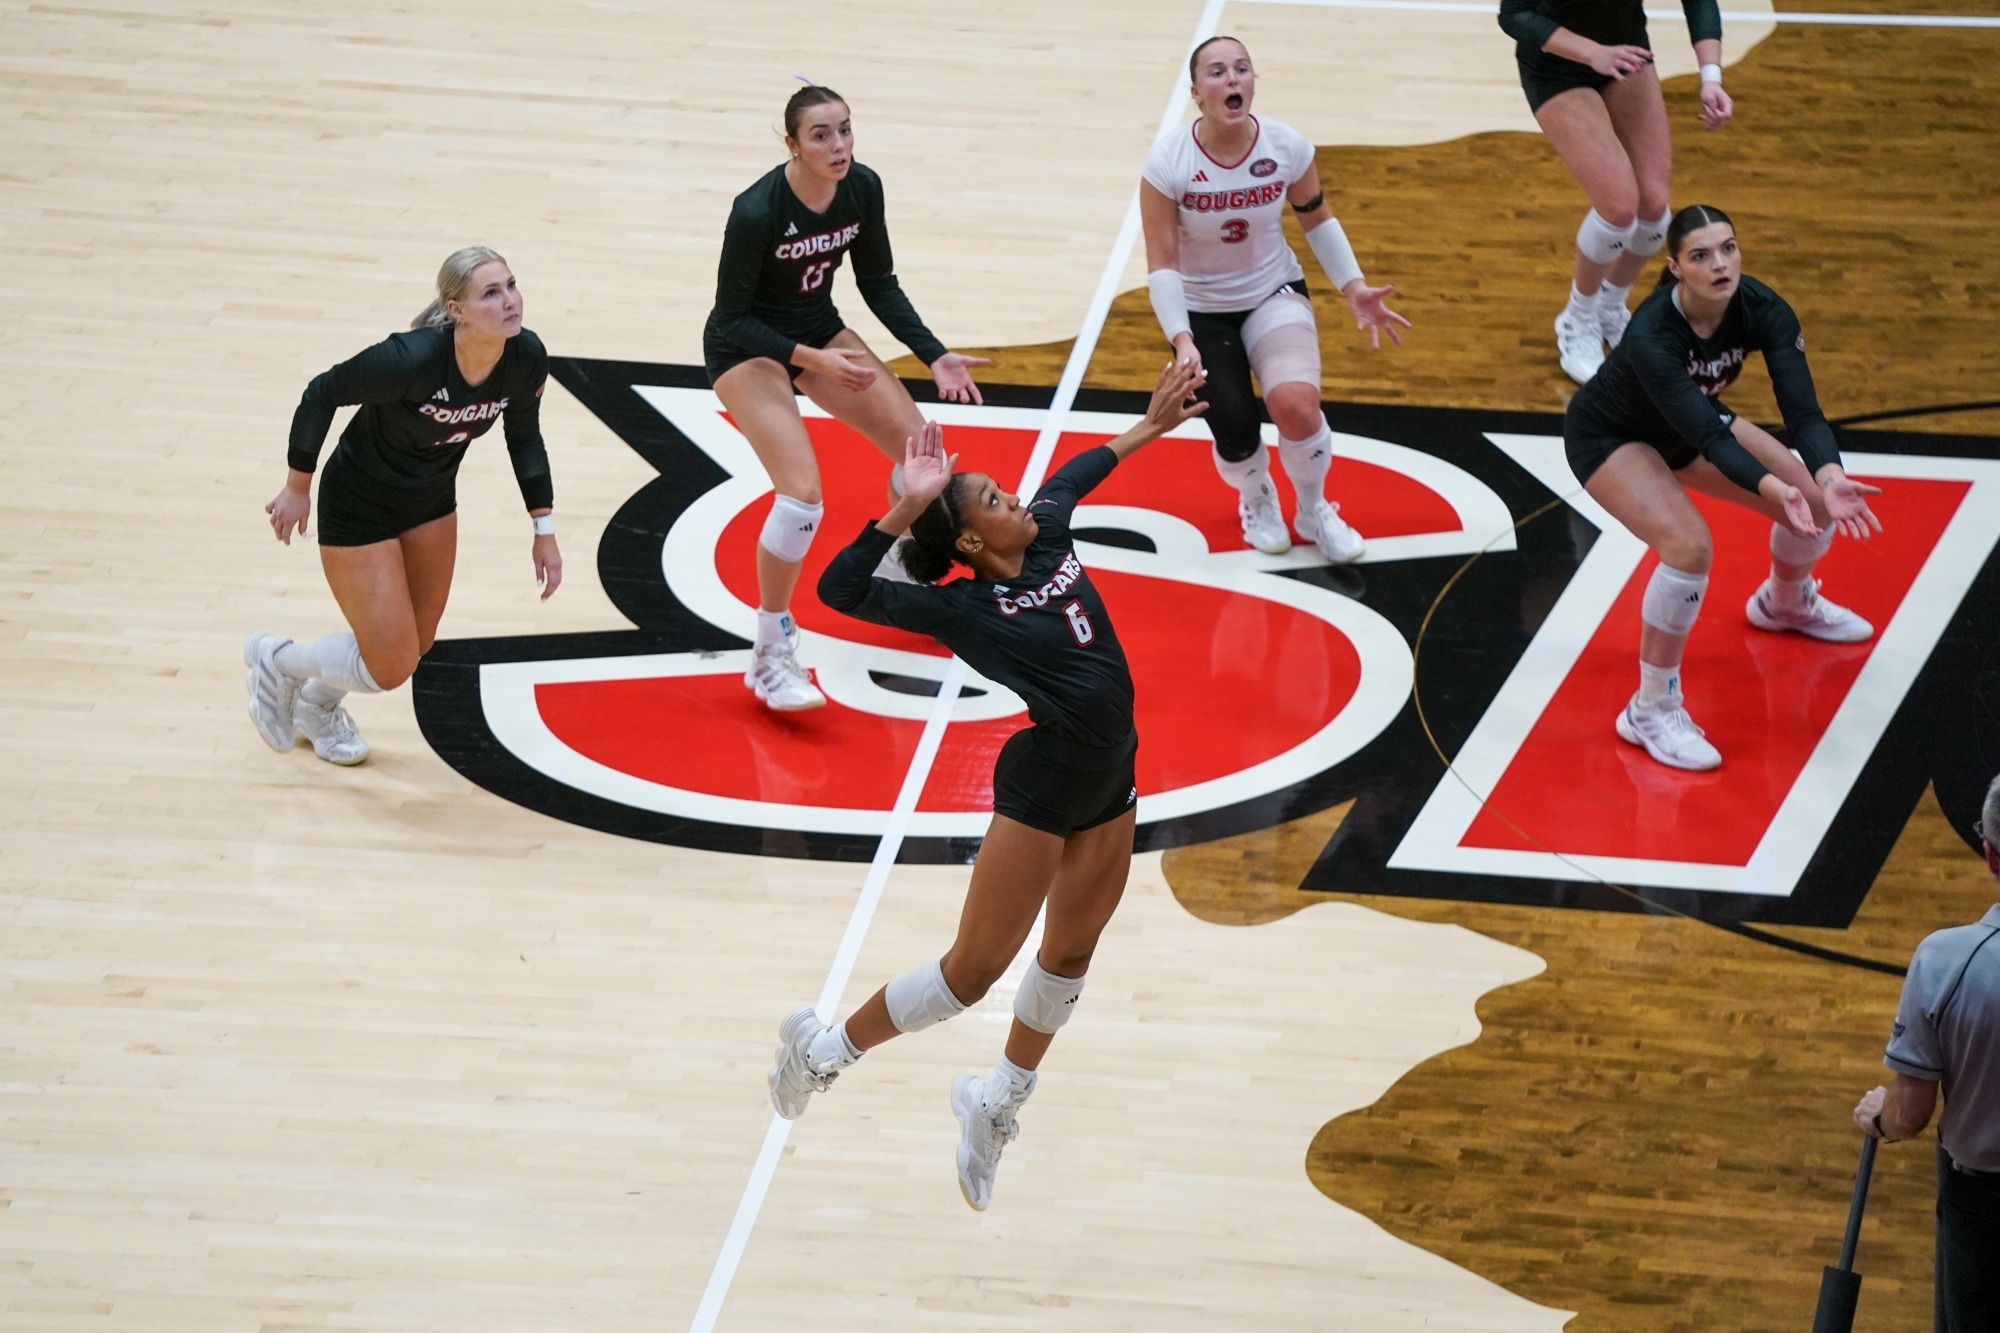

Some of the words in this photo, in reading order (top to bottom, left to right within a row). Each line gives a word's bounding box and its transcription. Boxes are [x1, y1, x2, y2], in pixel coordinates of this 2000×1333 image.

[1182, 181, 1284, 213] COUGARS
[1220, 218, 1249, 244] 3
[1064, 600, 1094, 646] 6
